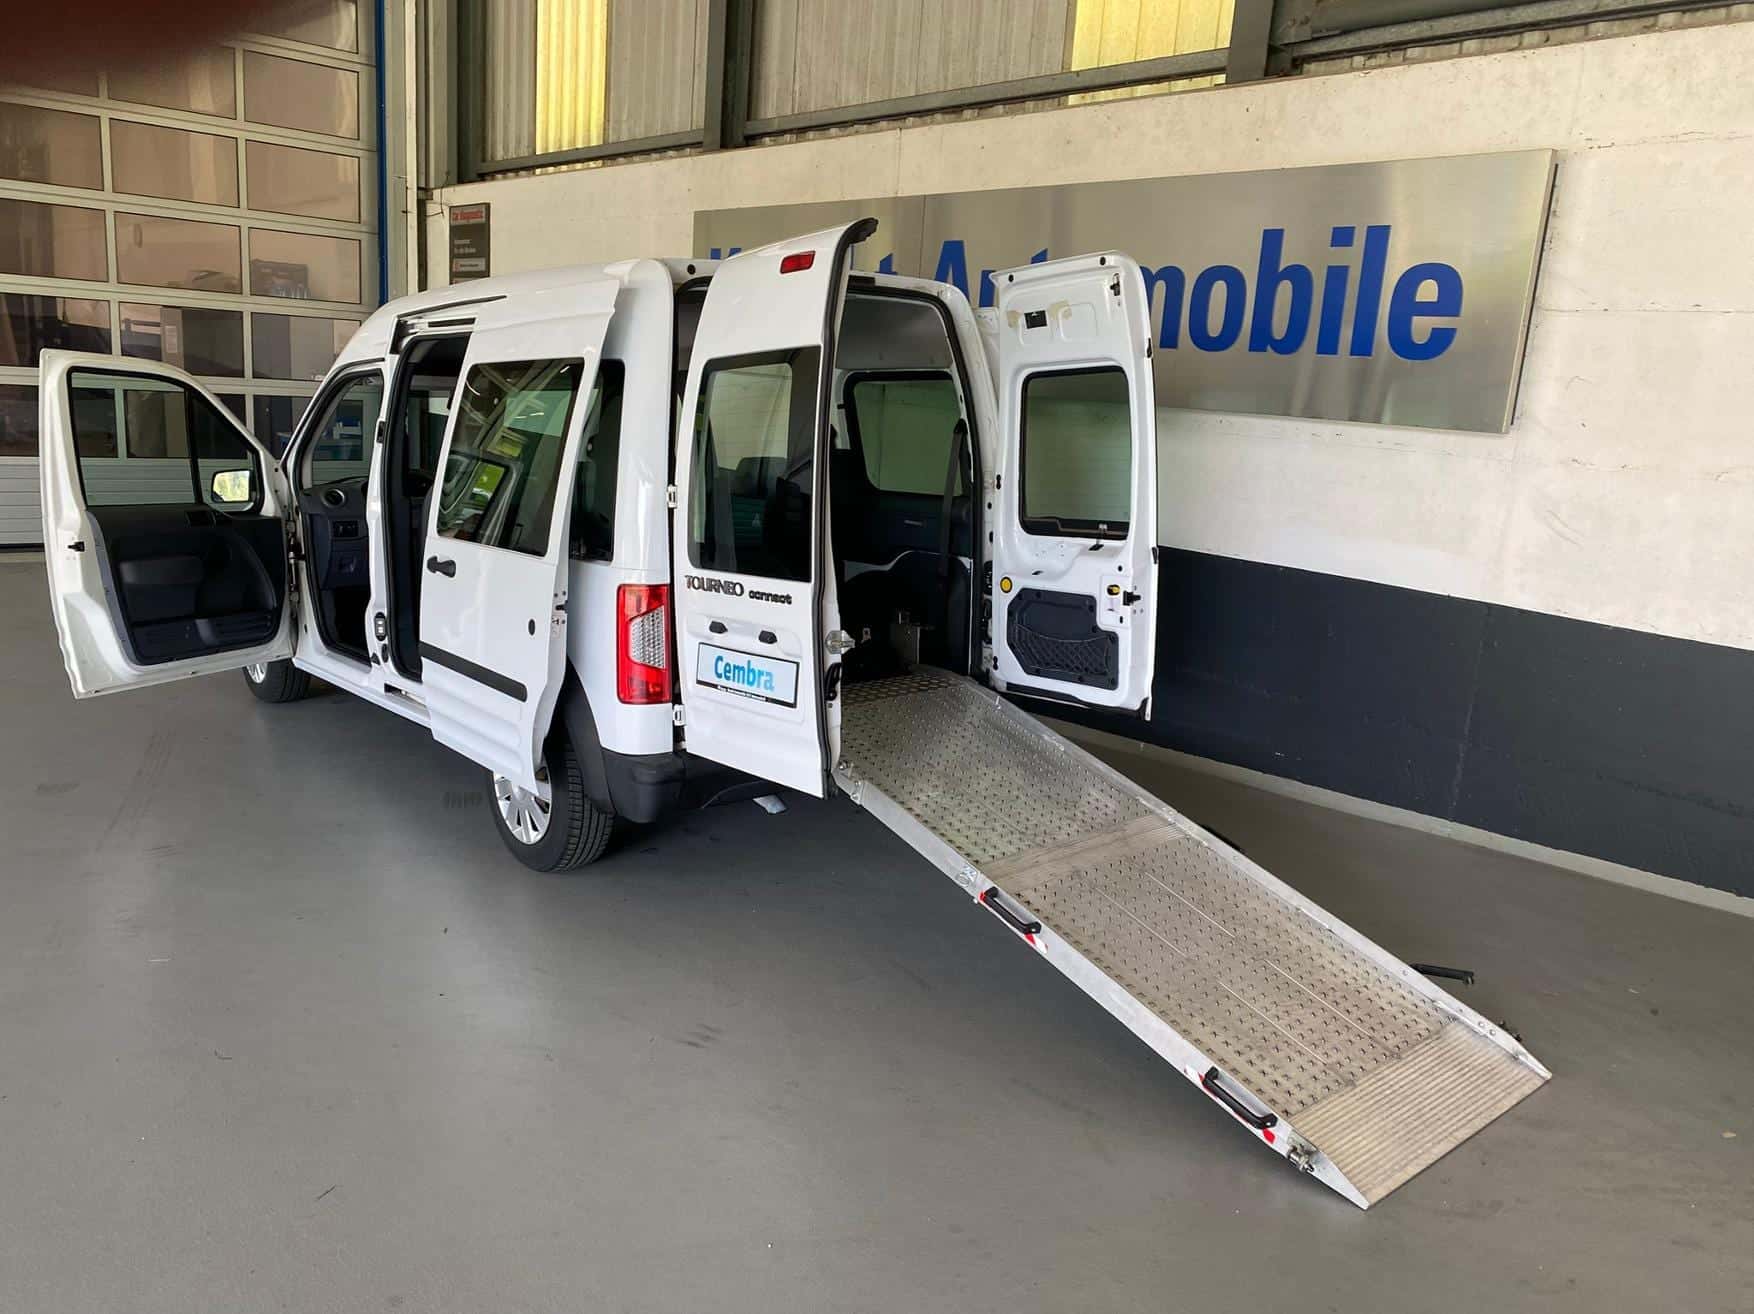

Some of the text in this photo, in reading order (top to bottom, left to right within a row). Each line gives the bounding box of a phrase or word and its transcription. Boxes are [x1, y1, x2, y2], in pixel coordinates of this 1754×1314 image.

[685, 575, 792, 605] TOURNEO connect
[714, 655, 775, 692] Cembra
